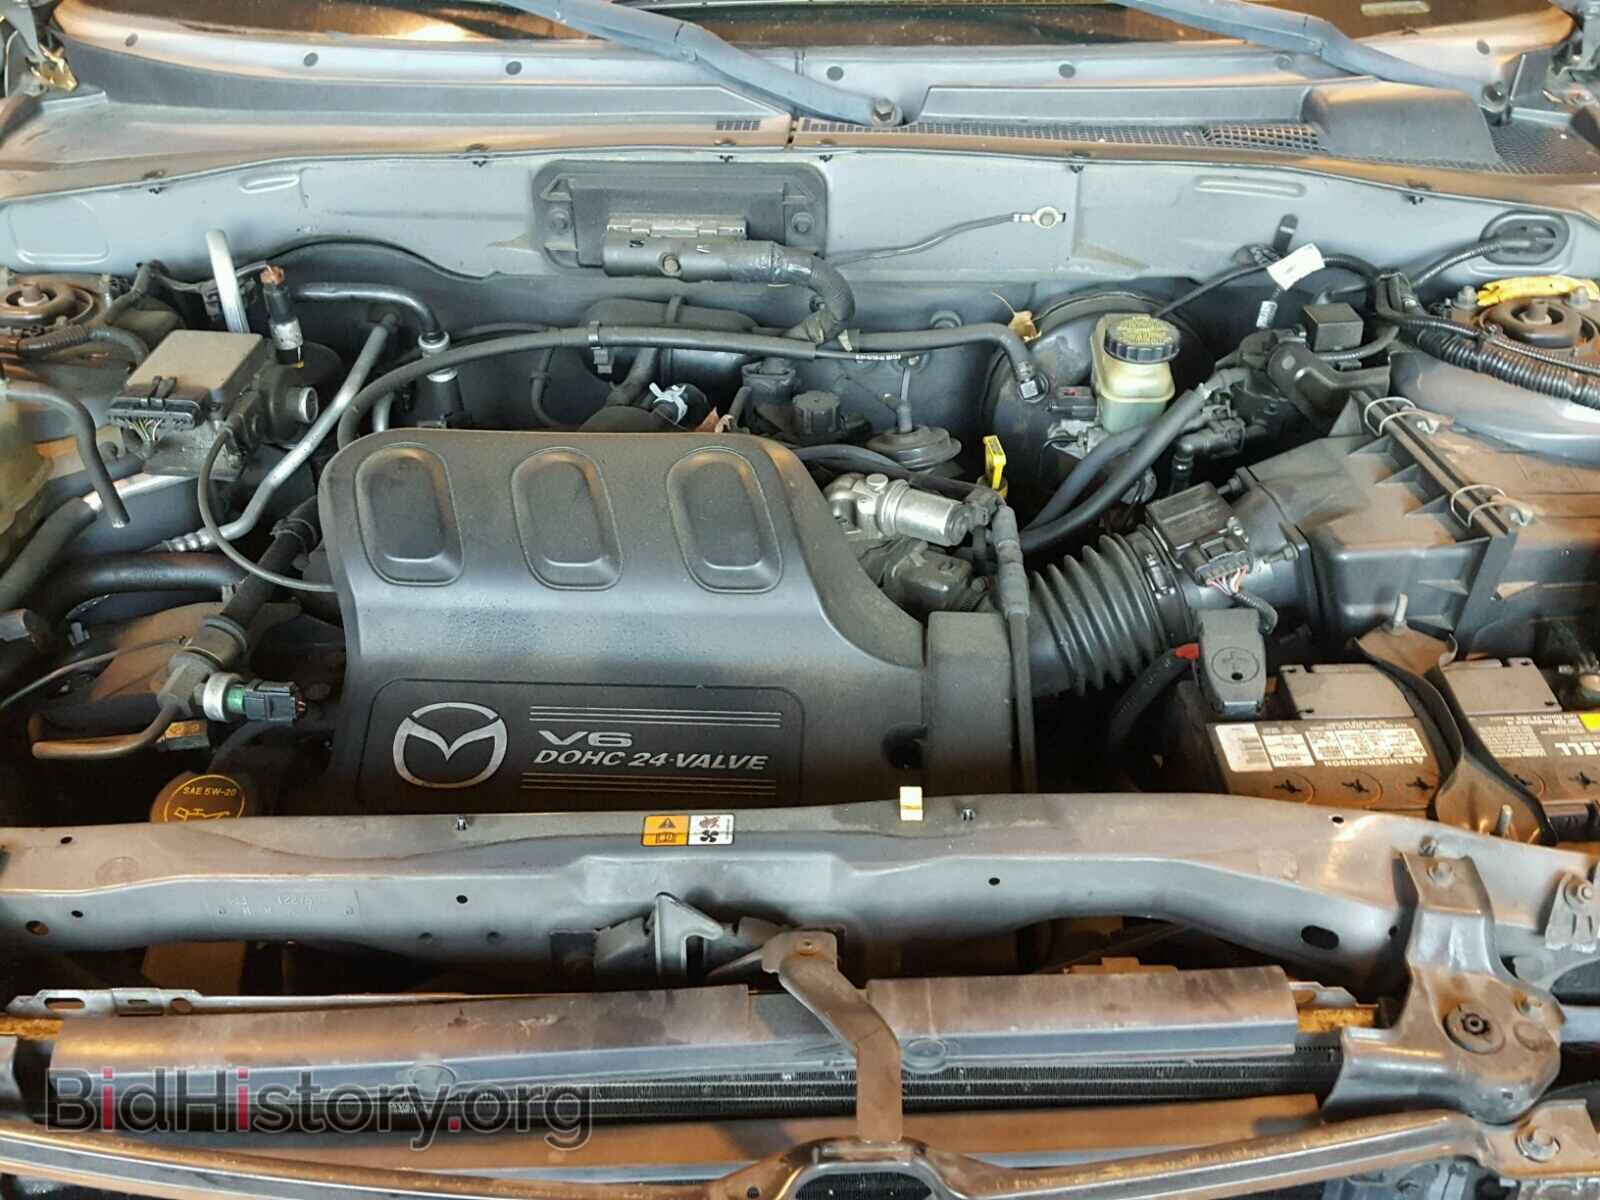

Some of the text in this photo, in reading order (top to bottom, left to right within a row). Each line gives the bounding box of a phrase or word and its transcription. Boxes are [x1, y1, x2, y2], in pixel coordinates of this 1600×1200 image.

[538, 730, 632, 748] V6
[533, 749, 769, 771] DOHC 24-VALVE
[183, 786, 237, 798] SAE 5W-20
